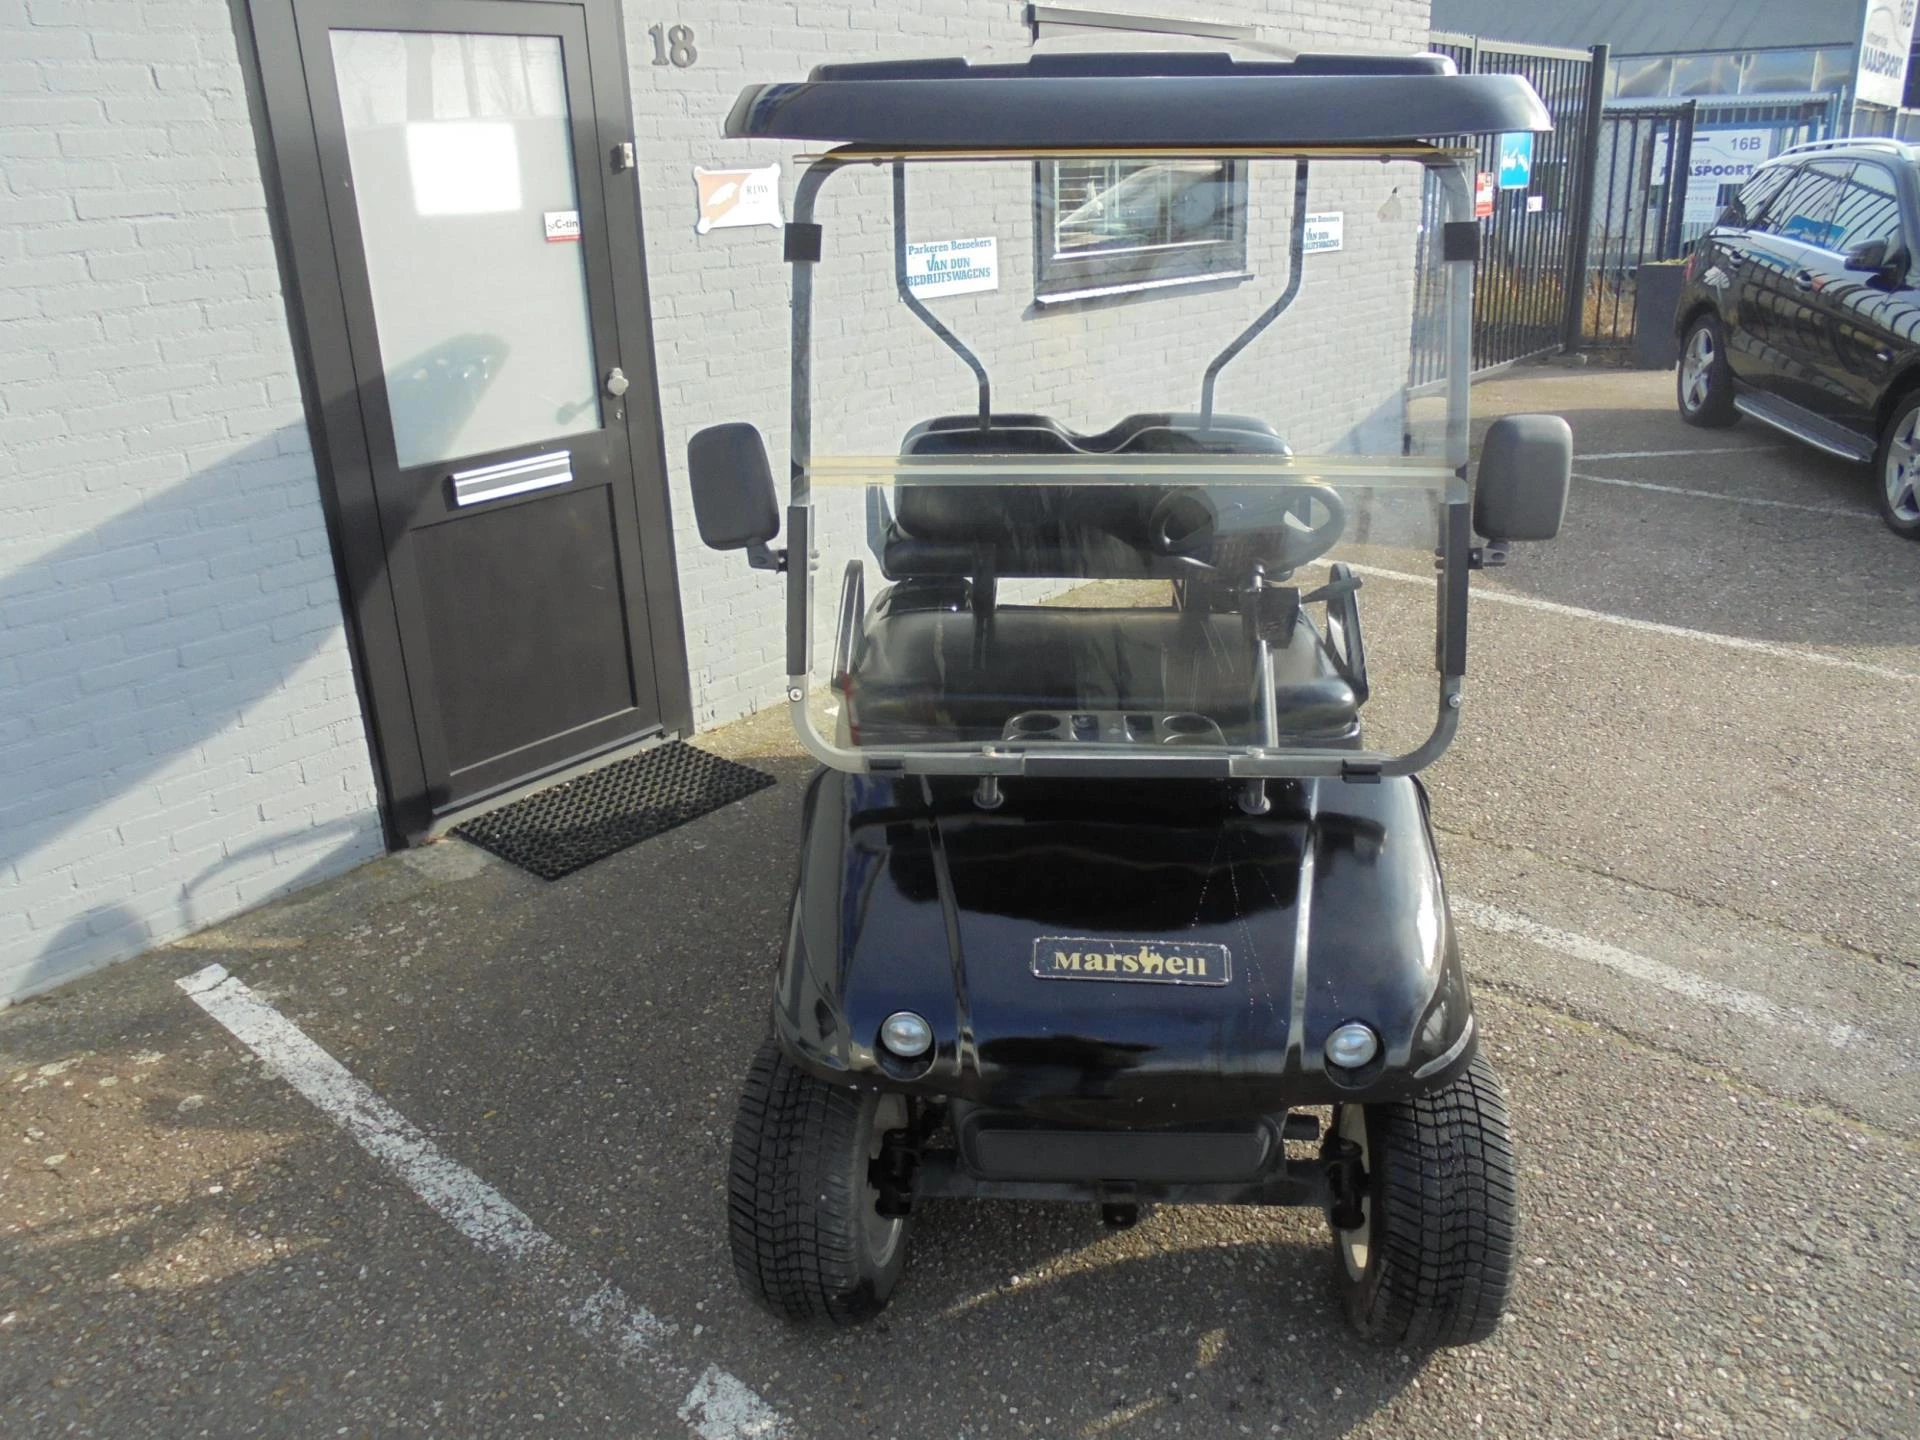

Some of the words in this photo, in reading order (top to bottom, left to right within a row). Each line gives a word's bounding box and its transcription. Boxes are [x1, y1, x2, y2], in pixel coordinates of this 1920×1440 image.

[648, 22, 698, 68] 18
[1730, 137, 1762, 151] 16B
[908, 244, 949, 256] Parkeren
[951, 239, 992, 251] Bezoekers
[926, 254, 948, 272] VAN
[951, 257, 971, 270] DUN
[904, 267, 991, 287] BEDRIJFSWAGENS
[1053, 946, 1208, 976] Marshell
